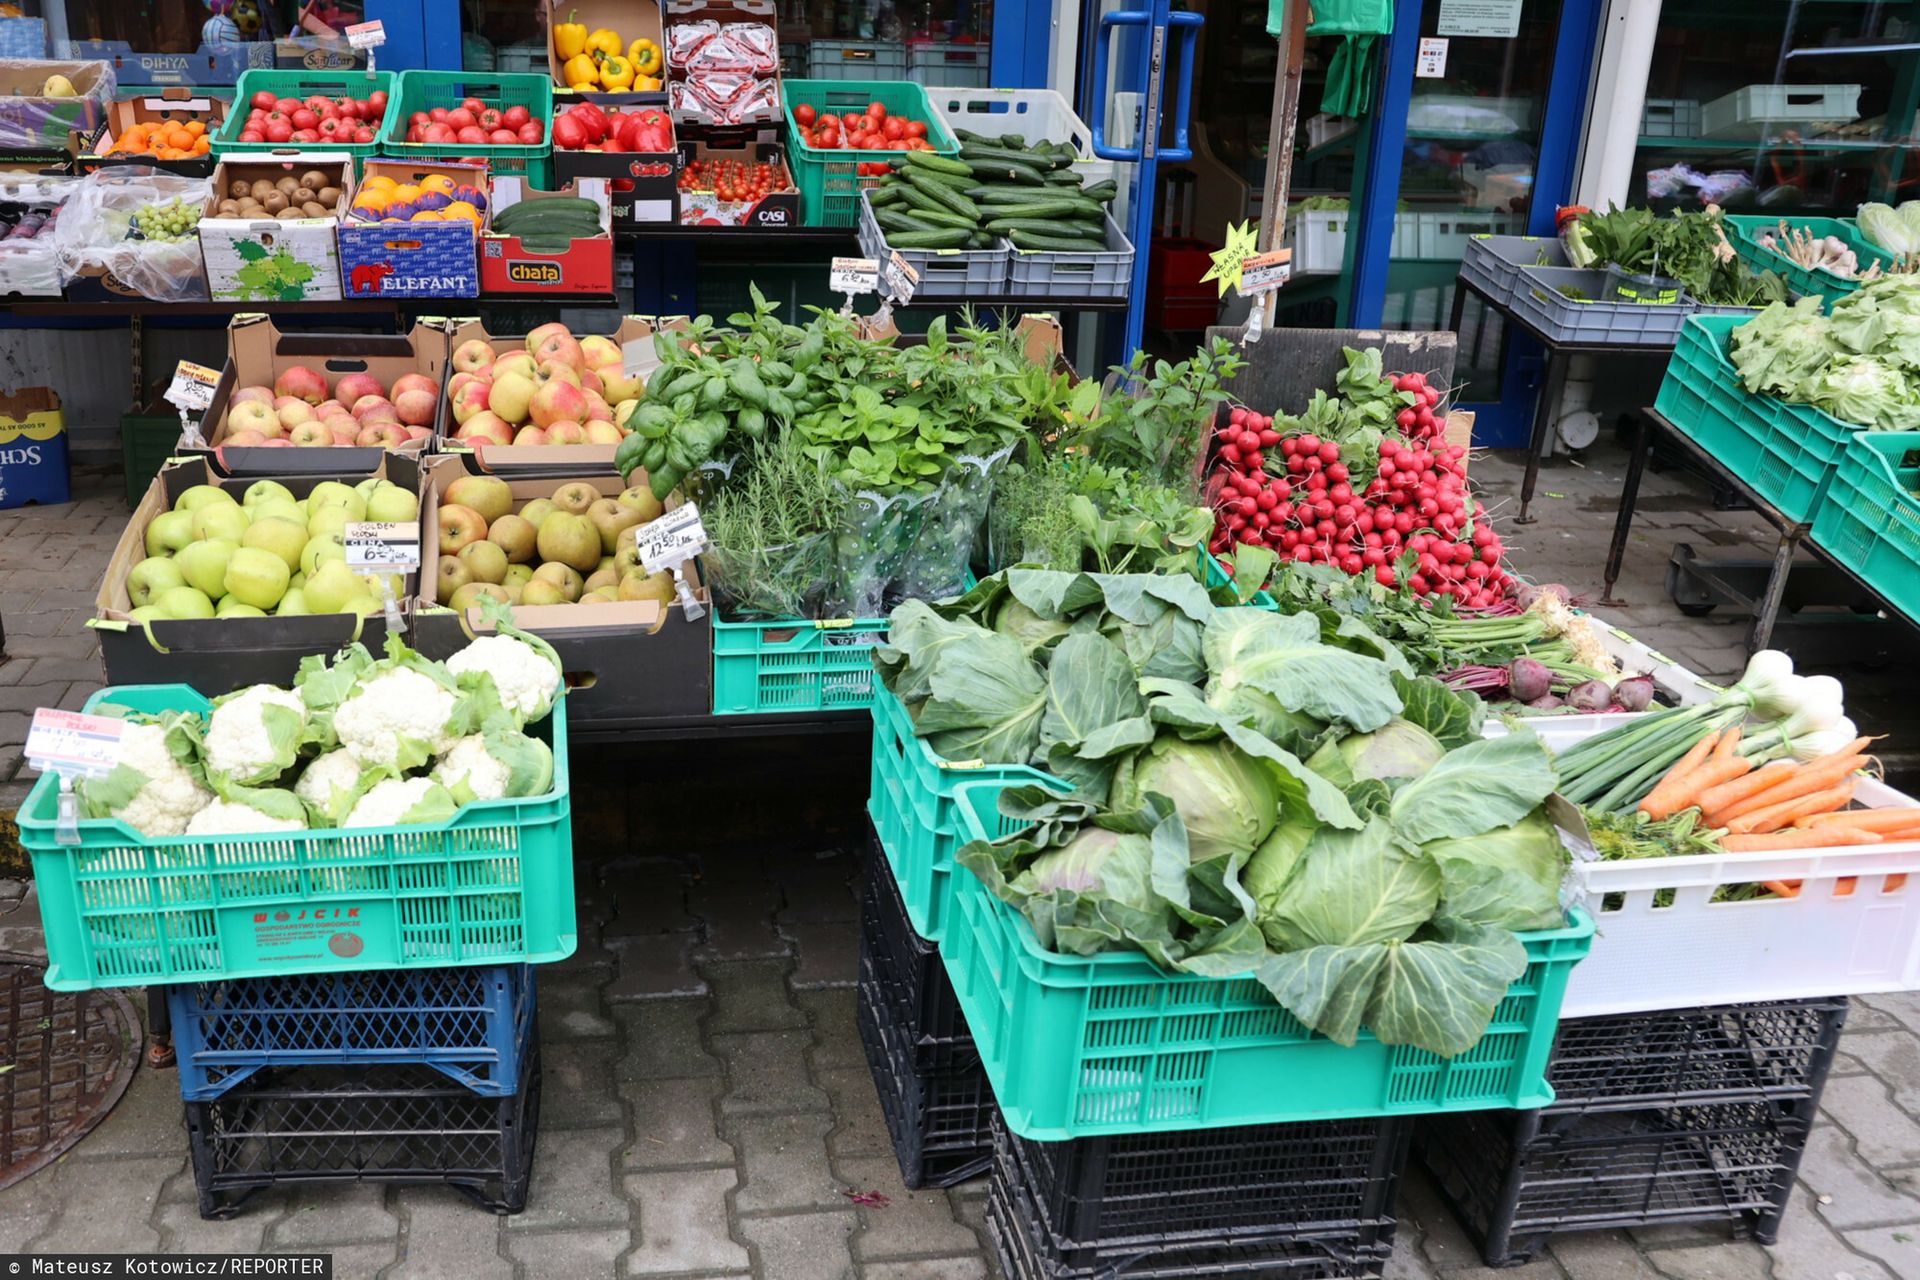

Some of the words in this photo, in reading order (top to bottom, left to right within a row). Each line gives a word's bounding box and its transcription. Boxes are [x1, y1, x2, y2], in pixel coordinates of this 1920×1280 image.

[142, 57, 189, 69] DIHYA
[758, 211, 786, 222] CASI
[511, 264, 559, 280] chata
[382, 277, 469, 290] ELEFANT
[357, 522, 397, 531] GOLDEN
